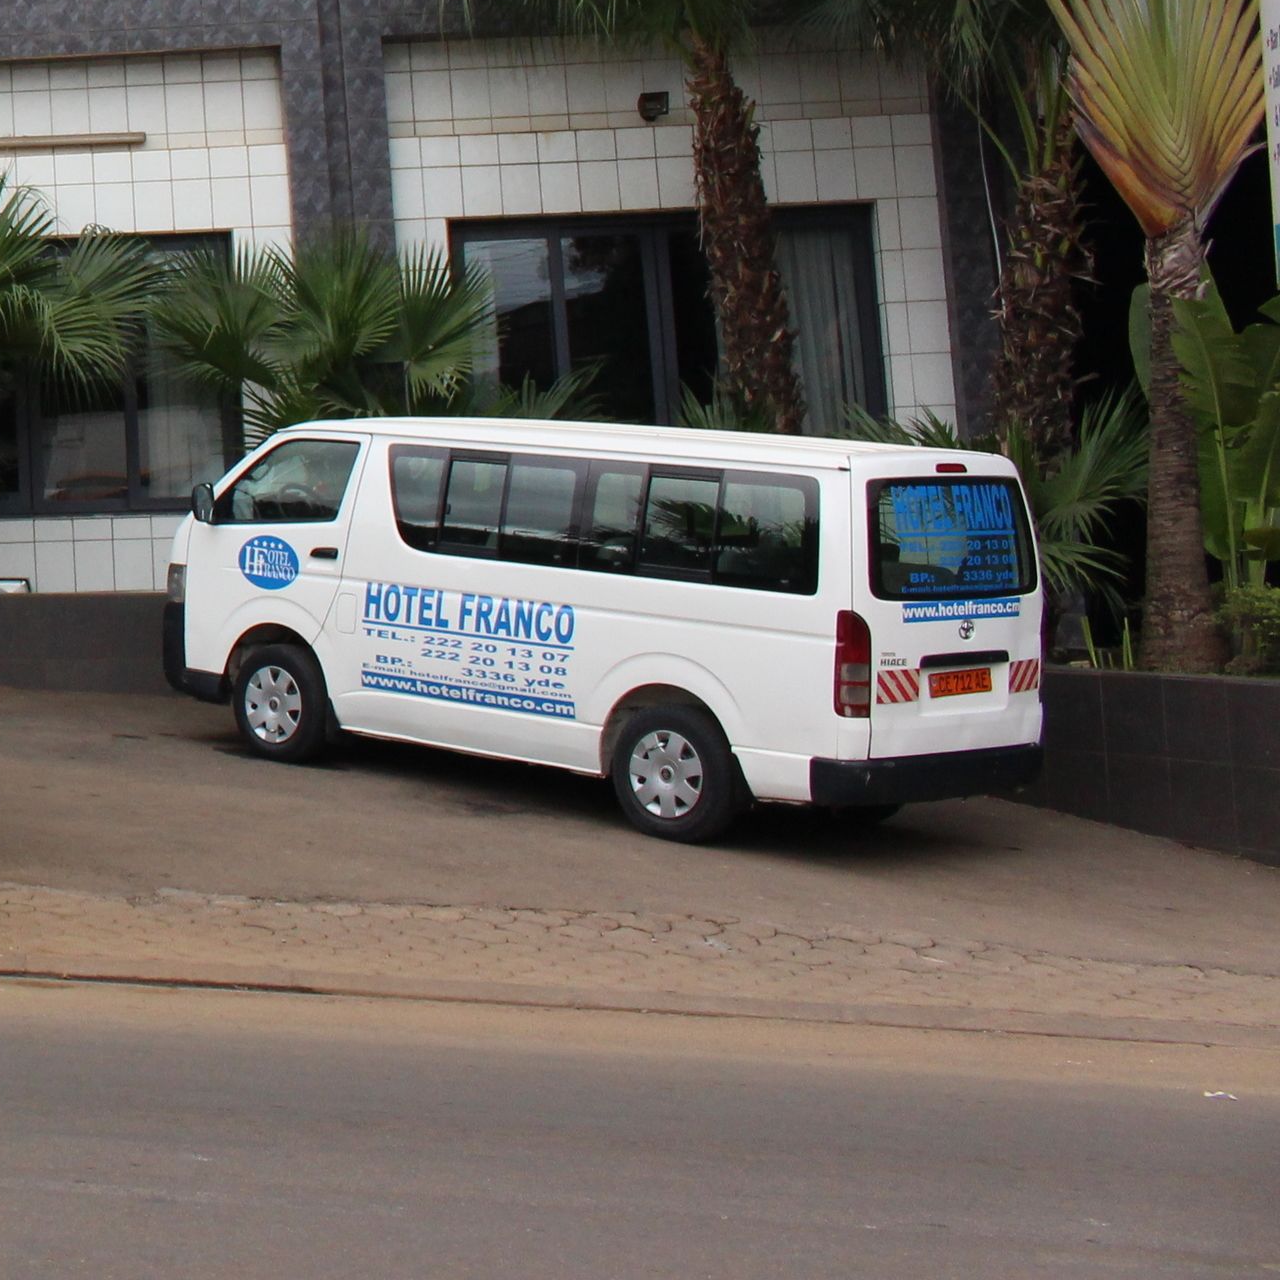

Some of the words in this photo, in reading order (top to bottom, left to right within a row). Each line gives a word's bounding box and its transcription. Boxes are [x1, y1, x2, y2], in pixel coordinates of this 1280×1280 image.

[892, 485, 953, 530] HOTEL
[951, 484, 1013, 529] FRANCO
[963, 570, 993, 582] 3336
[364, 582, 449, 629] HOTEL
[458, 592, 575, 644] FRANCO
[903, 598, 1020, 619] www.hotelfranco.cm
[420, 648, 460, 662] 222
[468, 655, 495, 667] 20
[503, 660, 530, 672] 13
[539, 665, 567, 677] 08
[423, 635, 463, 649] 222
[471, 641, 497, 654] 20
[506, 647, 533, 659] 13
[542, 651, 570, 663] 07
[880, 658, 907, 667] HIACE
[461, 666, 516, 683] 3336
[524, 677, 565, 689] yde
[361, 674, 575, 716] www.hotelfranco.cm
